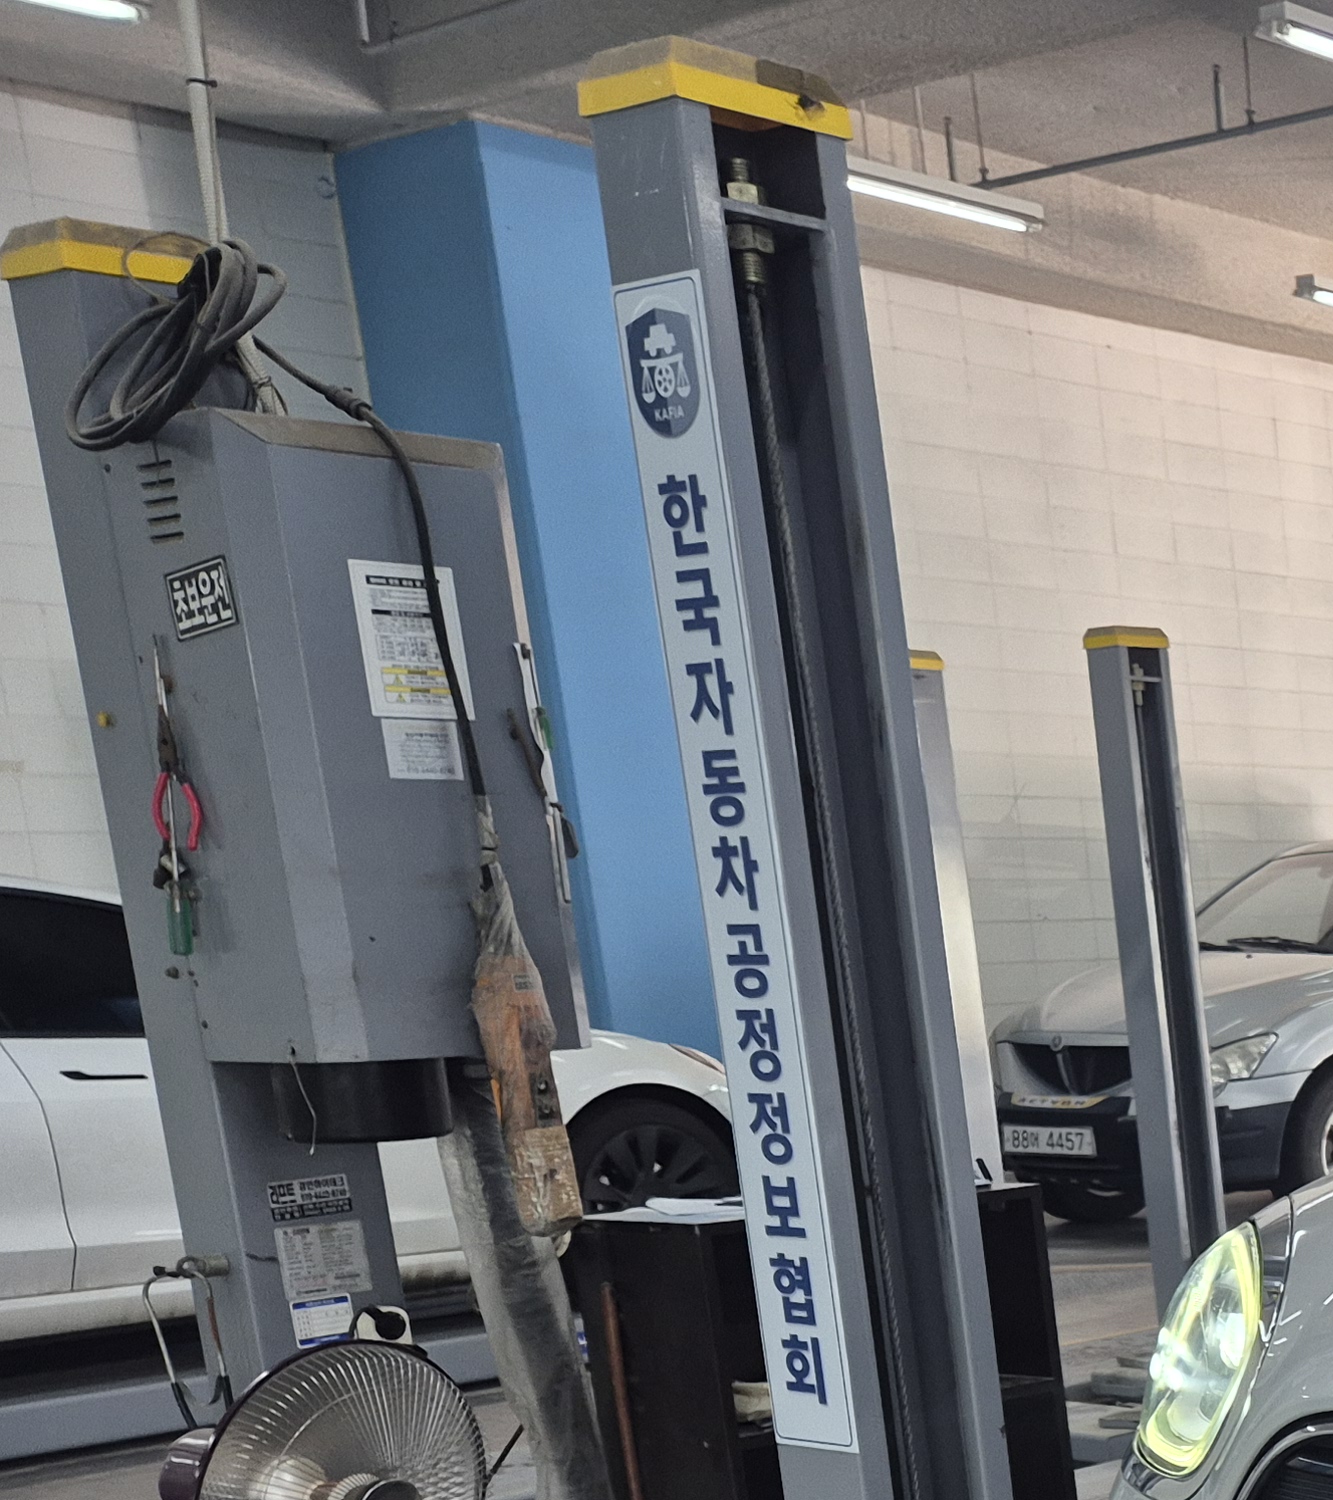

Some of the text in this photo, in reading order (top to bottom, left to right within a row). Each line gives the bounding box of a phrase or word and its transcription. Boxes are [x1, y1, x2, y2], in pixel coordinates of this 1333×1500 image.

[654, 405, 685, 422] KAFIA
[172, 565, 233, 631] 초보운전
[1045, 1130, 1085, 1151] 4457
